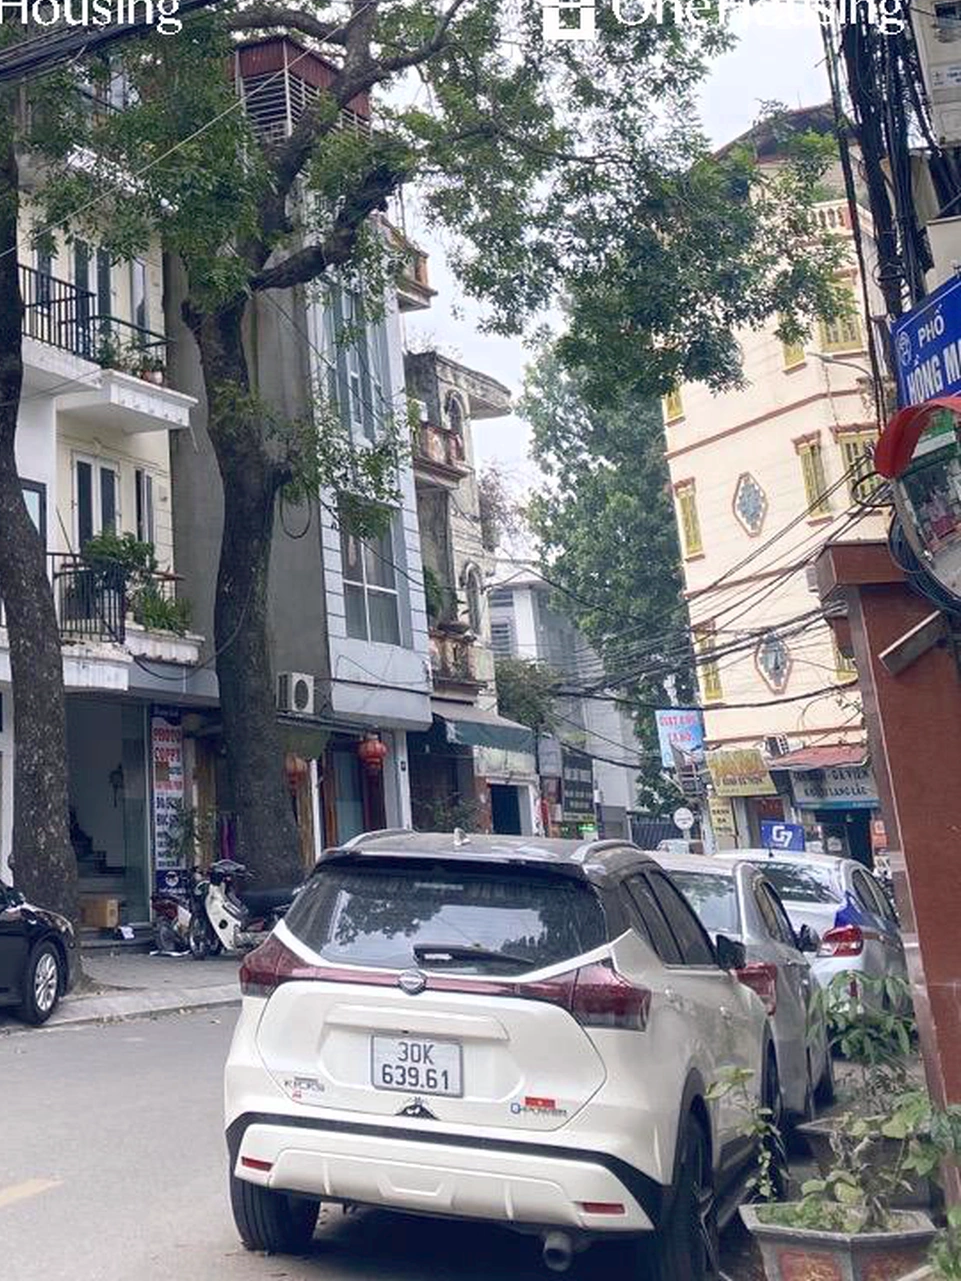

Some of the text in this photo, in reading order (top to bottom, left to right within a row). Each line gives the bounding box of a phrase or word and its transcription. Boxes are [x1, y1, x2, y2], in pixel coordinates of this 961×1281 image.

[918, 304, 944, 347] PHỐ
[397, 1041, 435, 1066] 30K
[382, 1064, 449, 1091] 639.61
